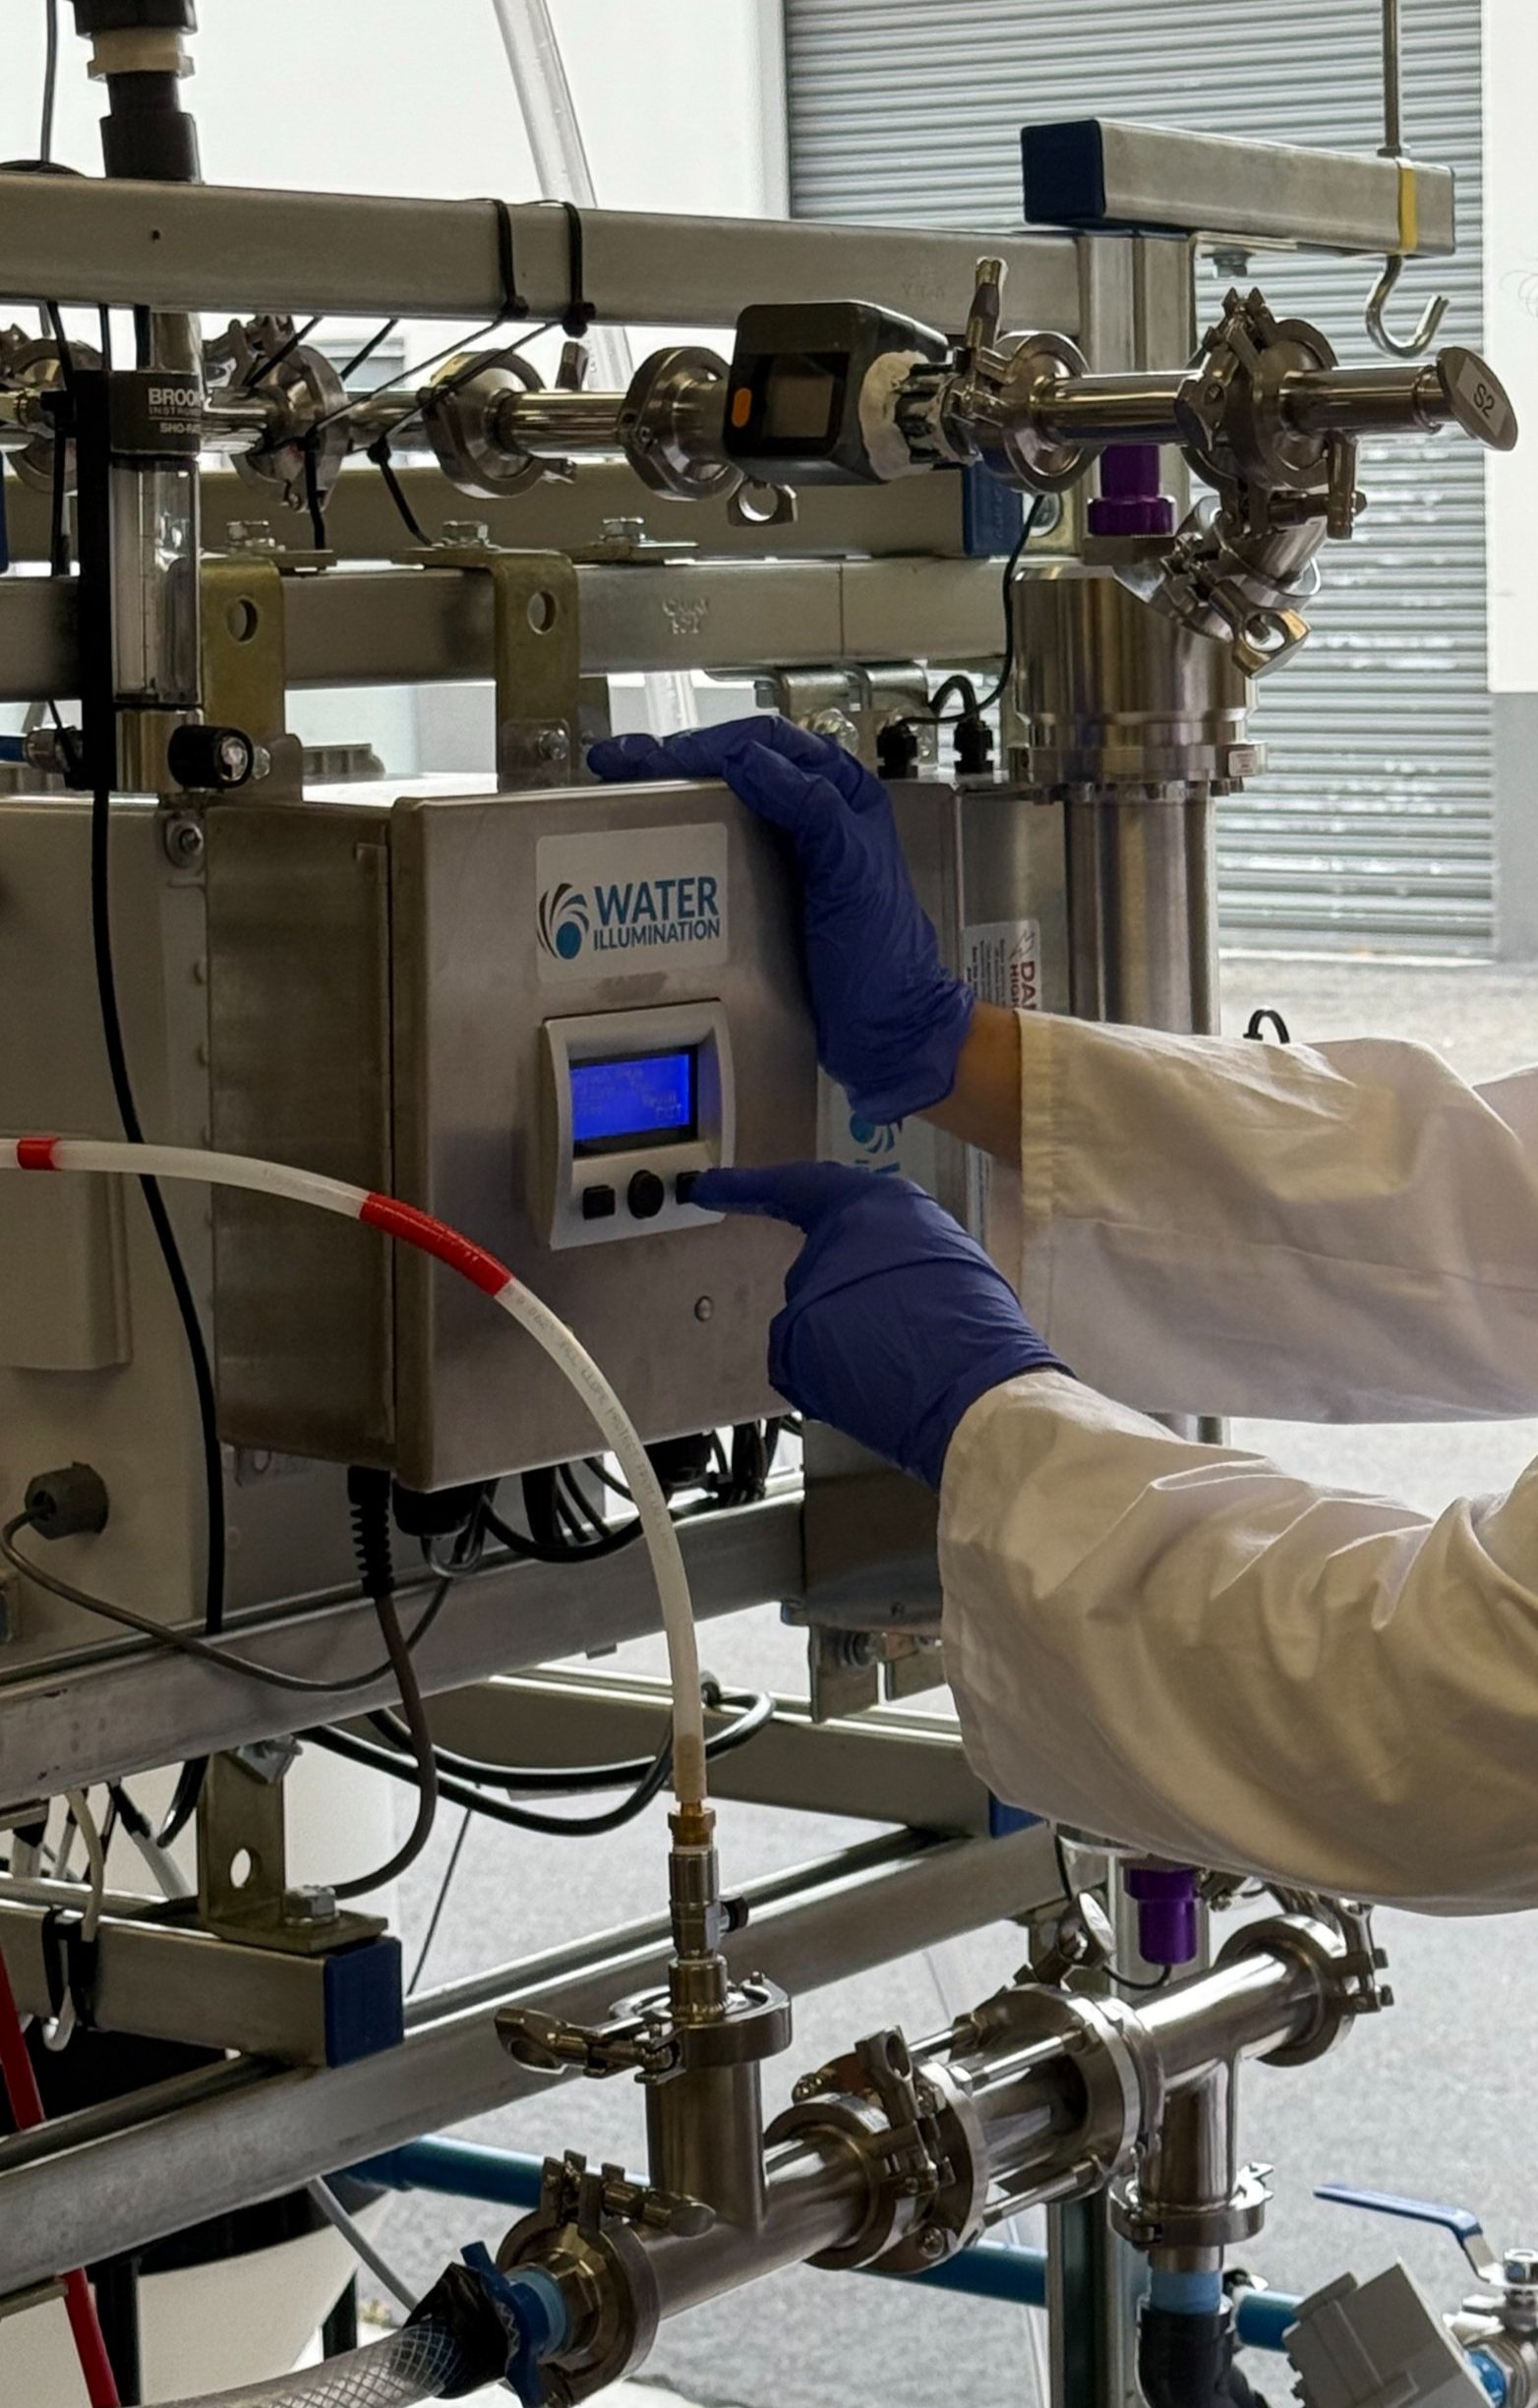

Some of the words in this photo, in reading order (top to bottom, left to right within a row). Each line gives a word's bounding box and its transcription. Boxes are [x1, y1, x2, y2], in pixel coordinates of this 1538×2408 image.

[1473, 382, 1495, 420] S2
[594, 876, 719, 927] WATER
[593, 918, 720, 952] ILLUMINATION
